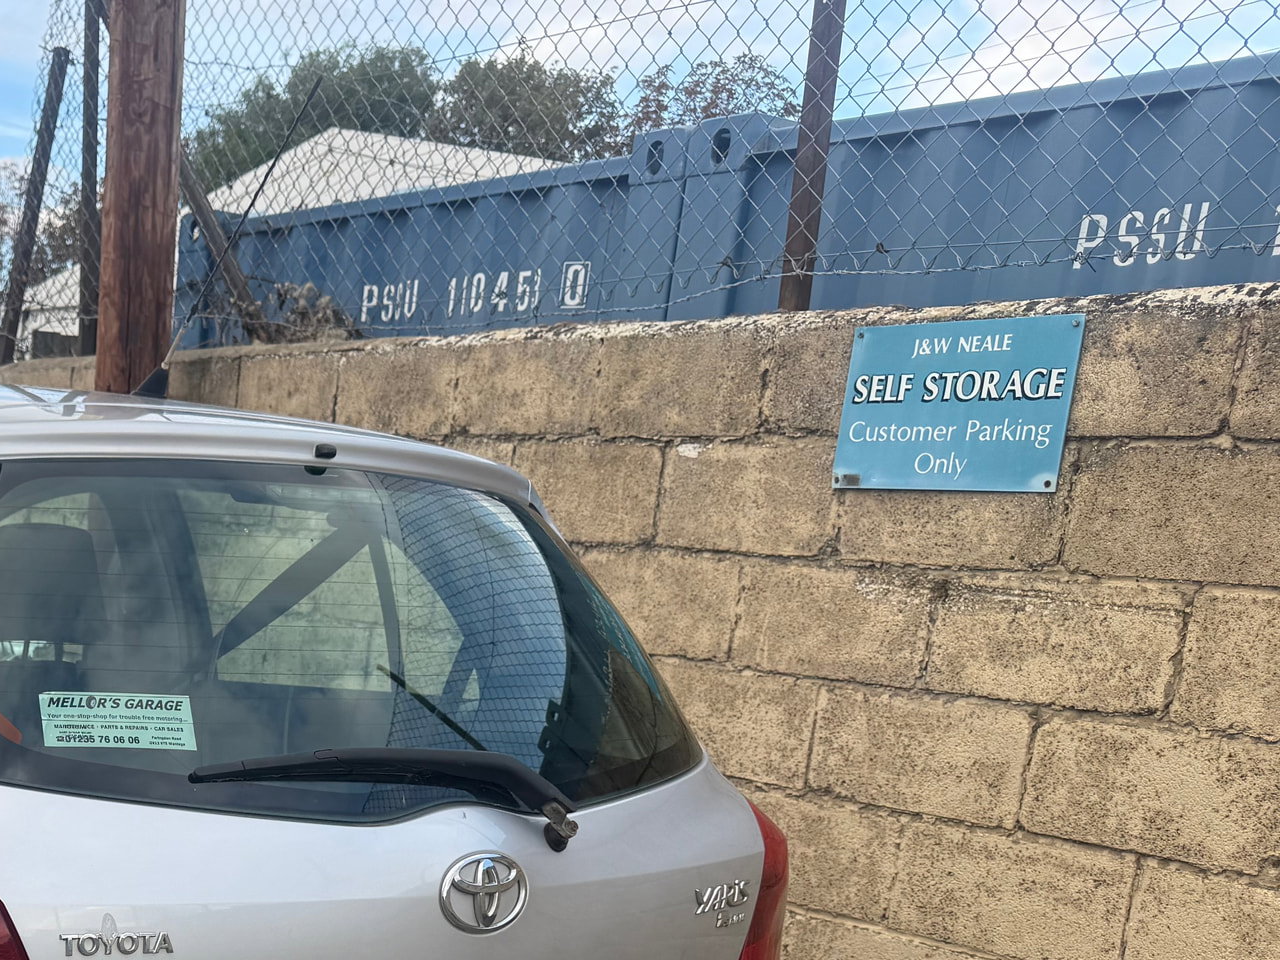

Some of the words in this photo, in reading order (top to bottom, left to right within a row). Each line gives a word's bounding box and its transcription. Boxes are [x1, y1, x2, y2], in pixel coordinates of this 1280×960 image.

[912, 336, 953, 359] J&W
[957, 334, 1013, 353] NEALE
[851, 374, 915, 403] SELF
[922, 368, 1067, 402] STORAGE
[849, 420, 957, 442] Customer
[966, 418, 1053, 449] Parking
[914, 451, 967, 480] Only
[47, 695, 121, 710] MELLOR'S
[124, 698, 184, 712] GARAGE
[98, 735, 111, 744] 76
[113, 735, 126, 744] 06
[127, 736, 140, 744] 06
[59, 931, 175, 957] TOYOTA
